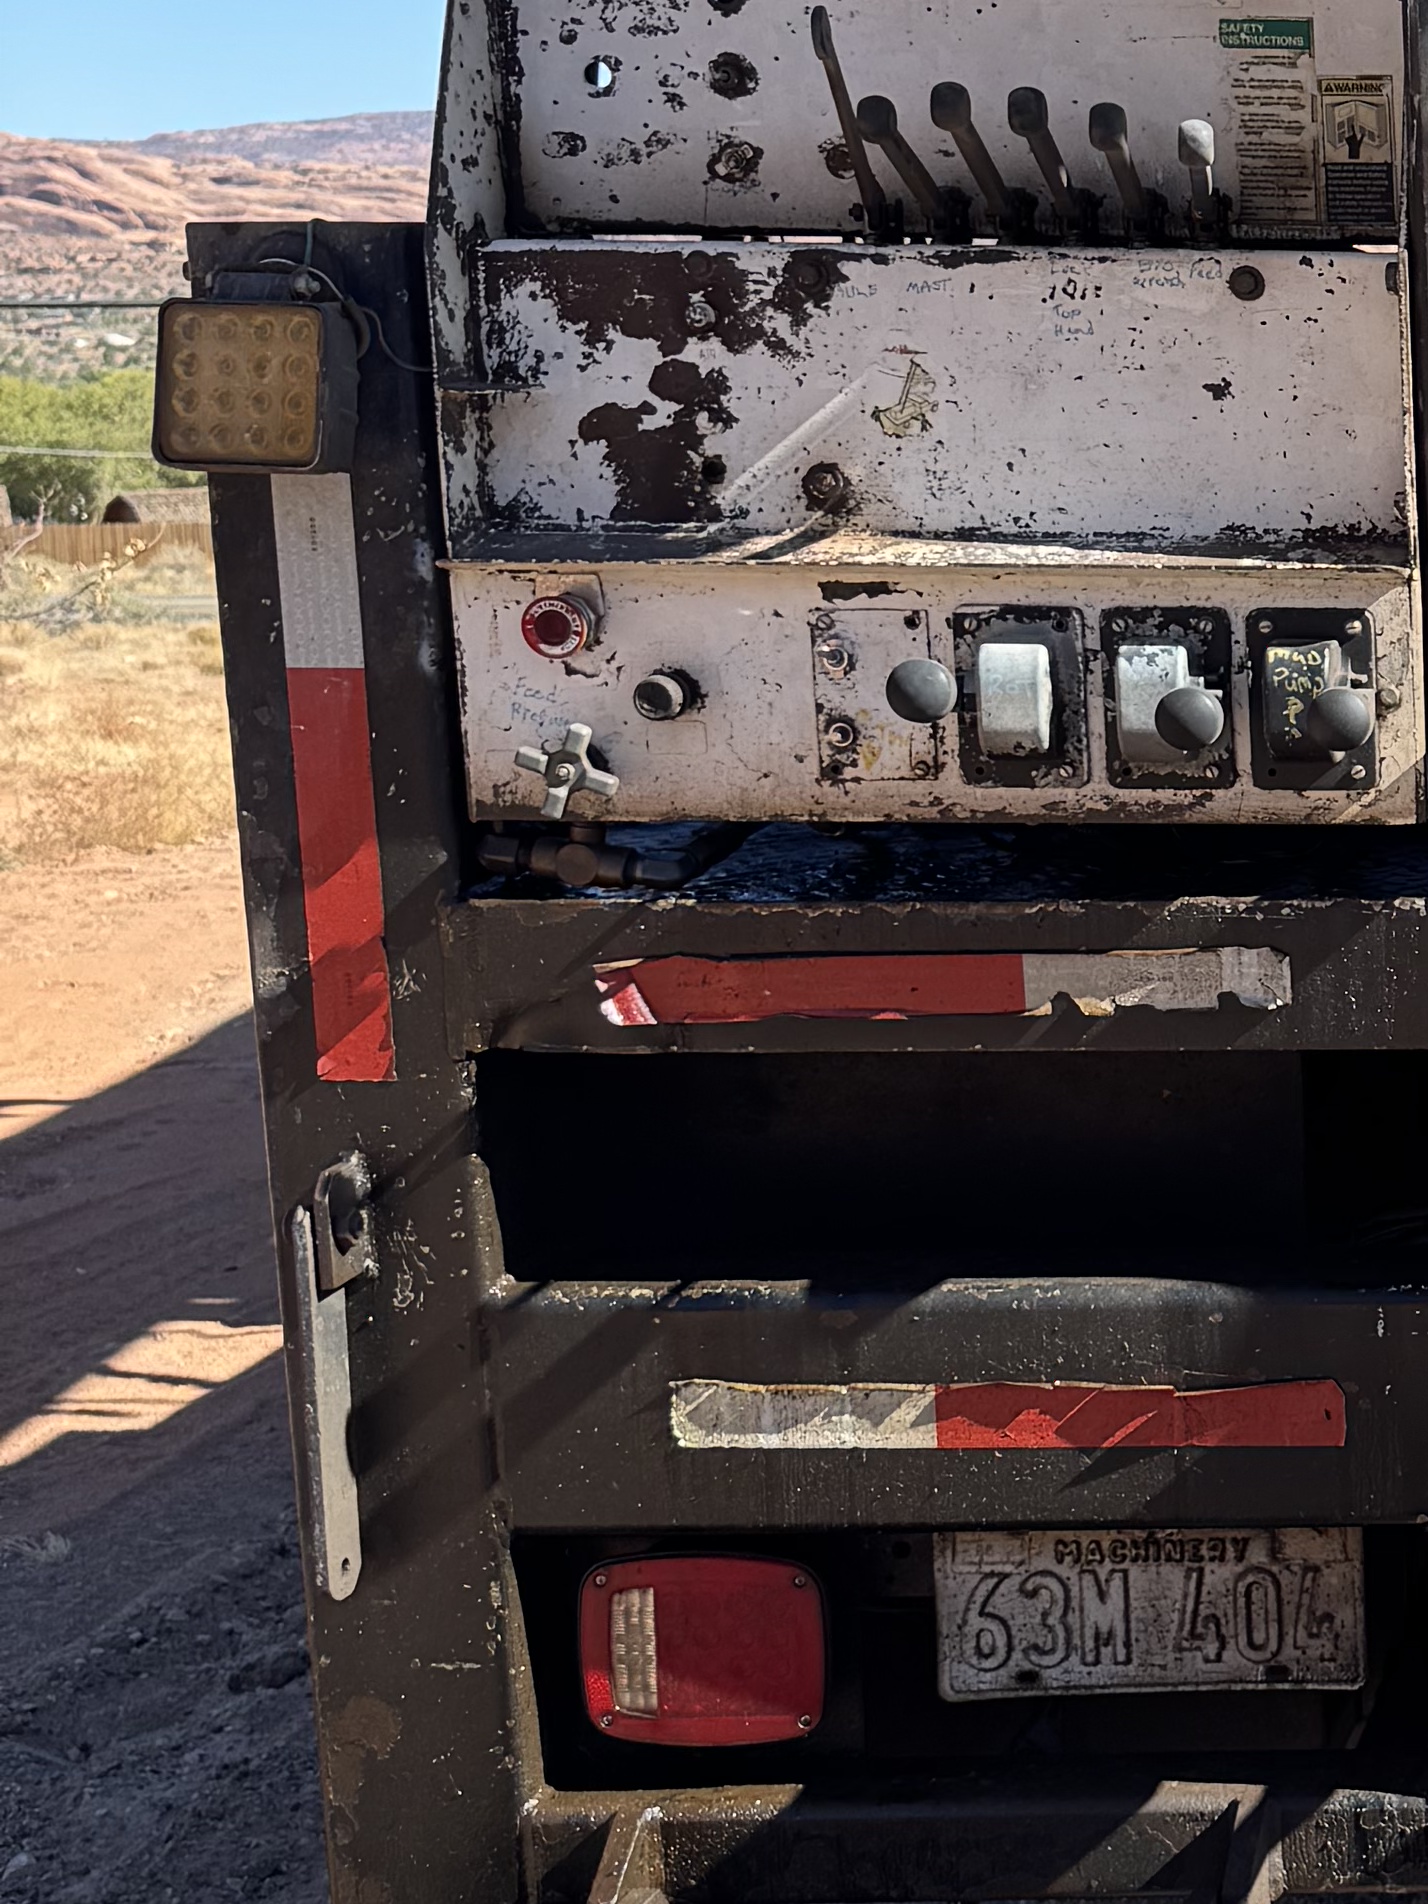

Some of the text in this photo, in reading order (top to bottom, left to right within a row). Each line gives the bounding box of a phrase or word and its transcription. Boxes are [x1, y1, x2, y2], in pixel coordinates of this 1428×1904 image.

[1222, 35, 1304, 47] INSTRUCTIONS
[1054, 1535, 1252, 1565] MACHINERY
[960, 1568, 1132, 1672] 63M
